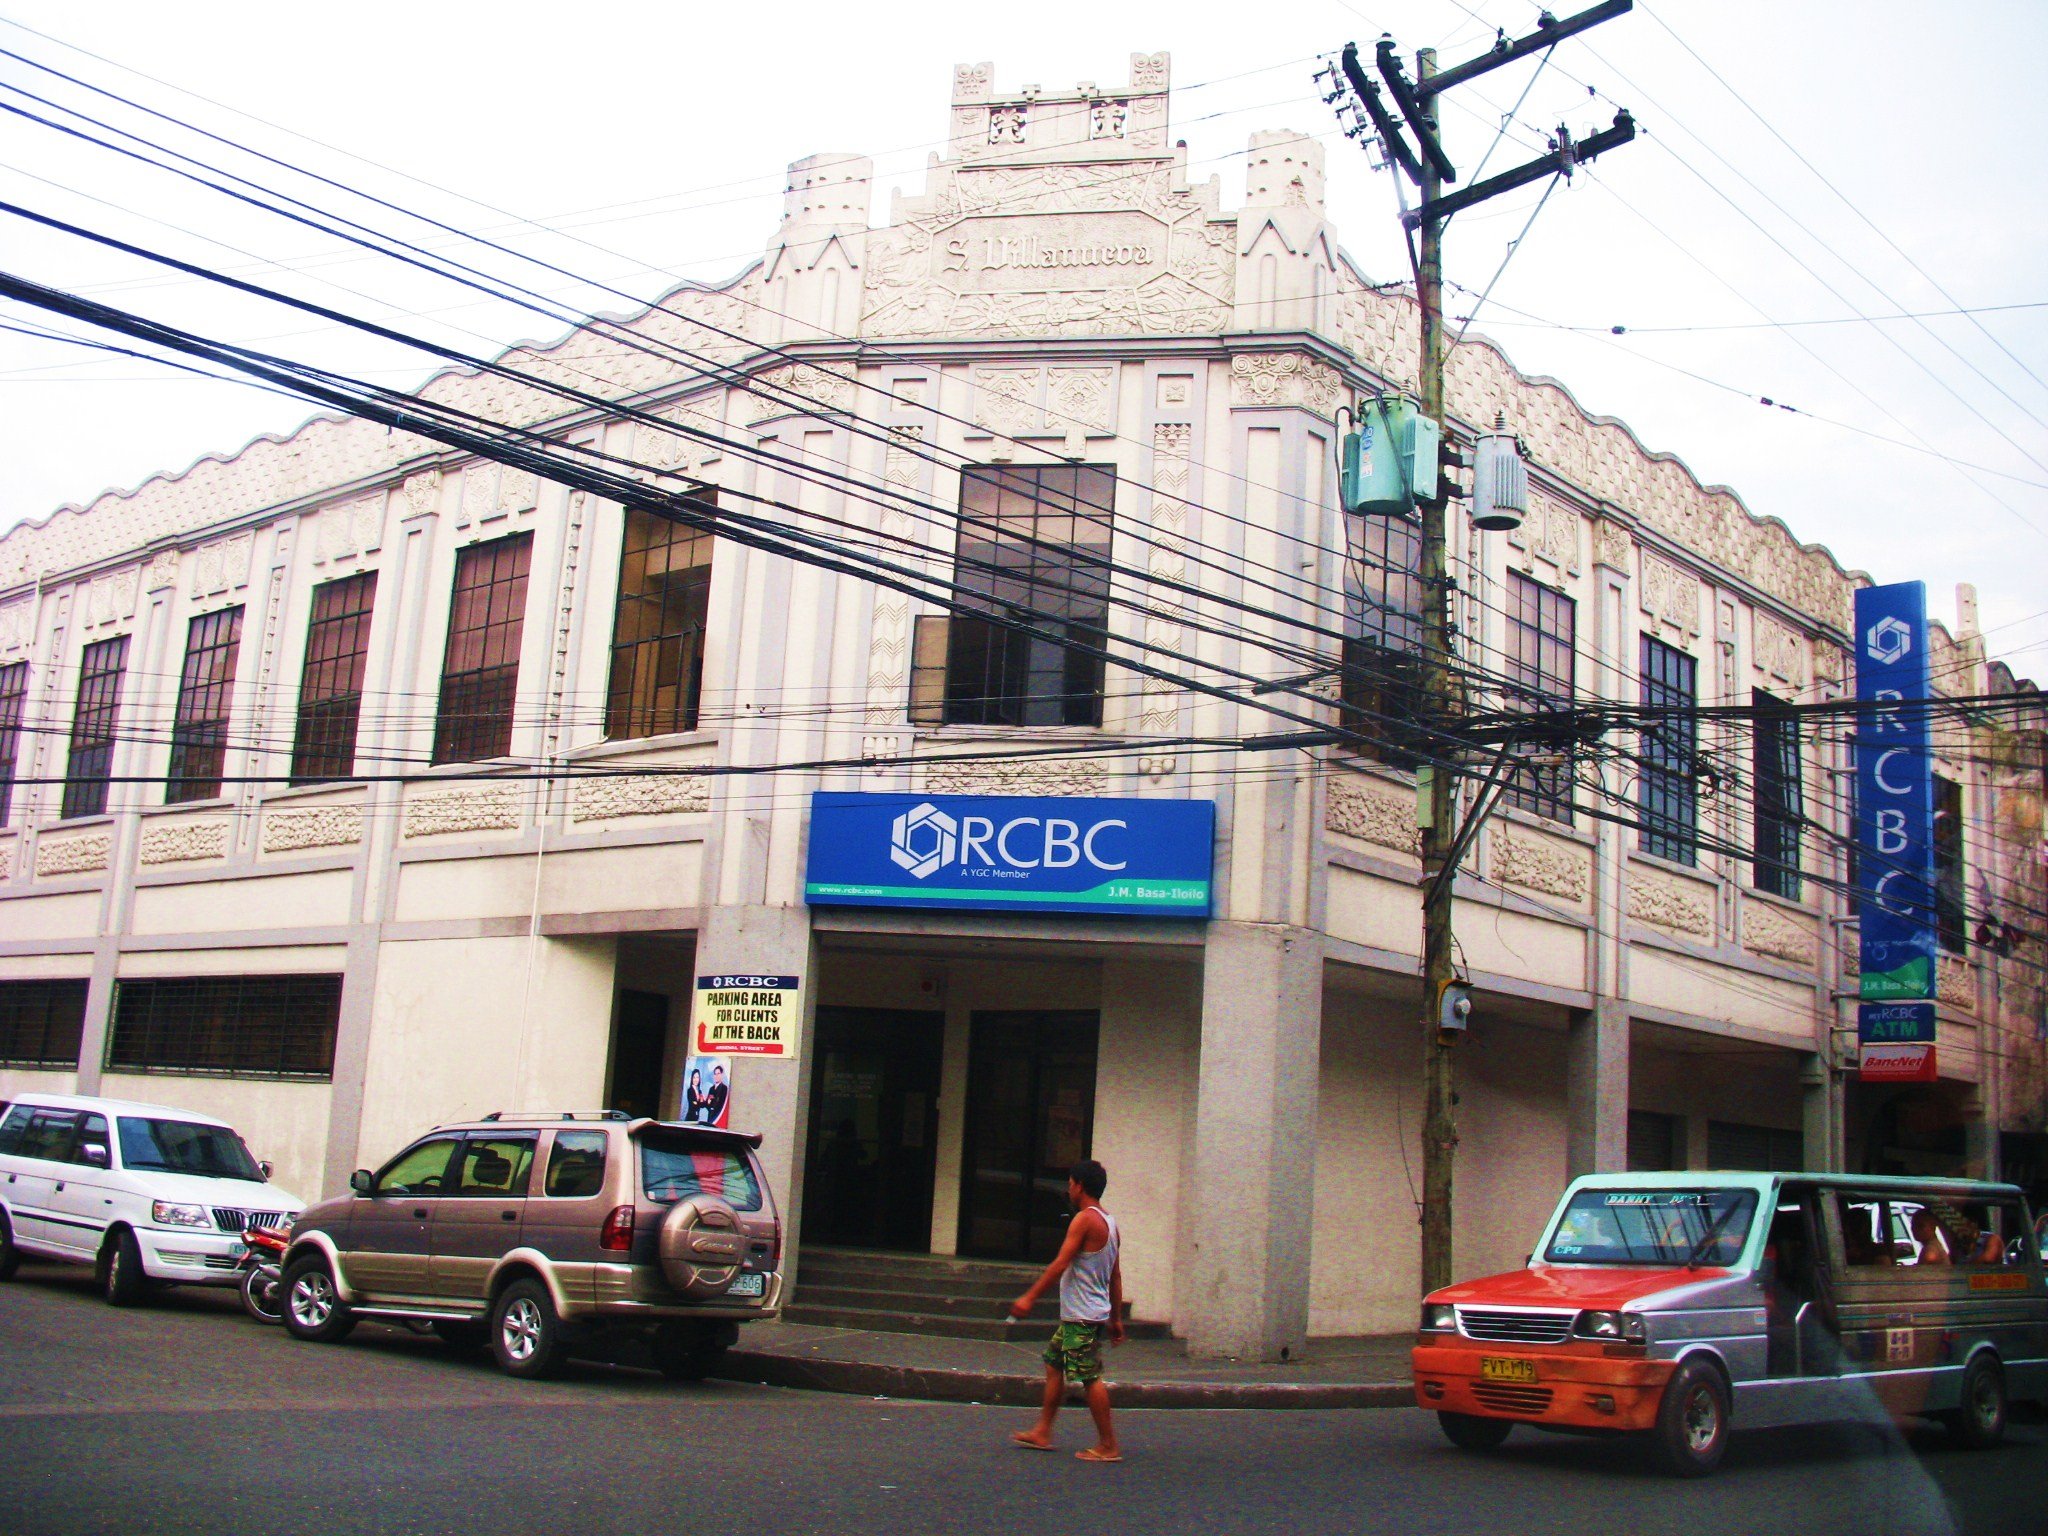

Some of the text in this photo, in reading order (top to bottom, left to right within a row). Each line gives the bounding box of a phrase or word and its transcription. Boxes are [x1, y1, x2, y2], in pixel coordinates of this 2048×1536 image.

[960, 816, 1127, 871] RCBC
[961, 869, 1030, 879] A YGC Member
[818, 886, 882, 895] www.rcbc.com
[1108, 887, 1132, 897] J.M.
[724, 976, 778, 987] RCBC
[707, 992, 782, 1006] PARKING AREA
[717, 1009, 778, 1023] FOR CLIENTS
[713, 1026, 780, 1040] AT THE BACK
[1872, 1021, 1918, 1036] ATM
[1865, 1057, 1923, 1067] BancNet
